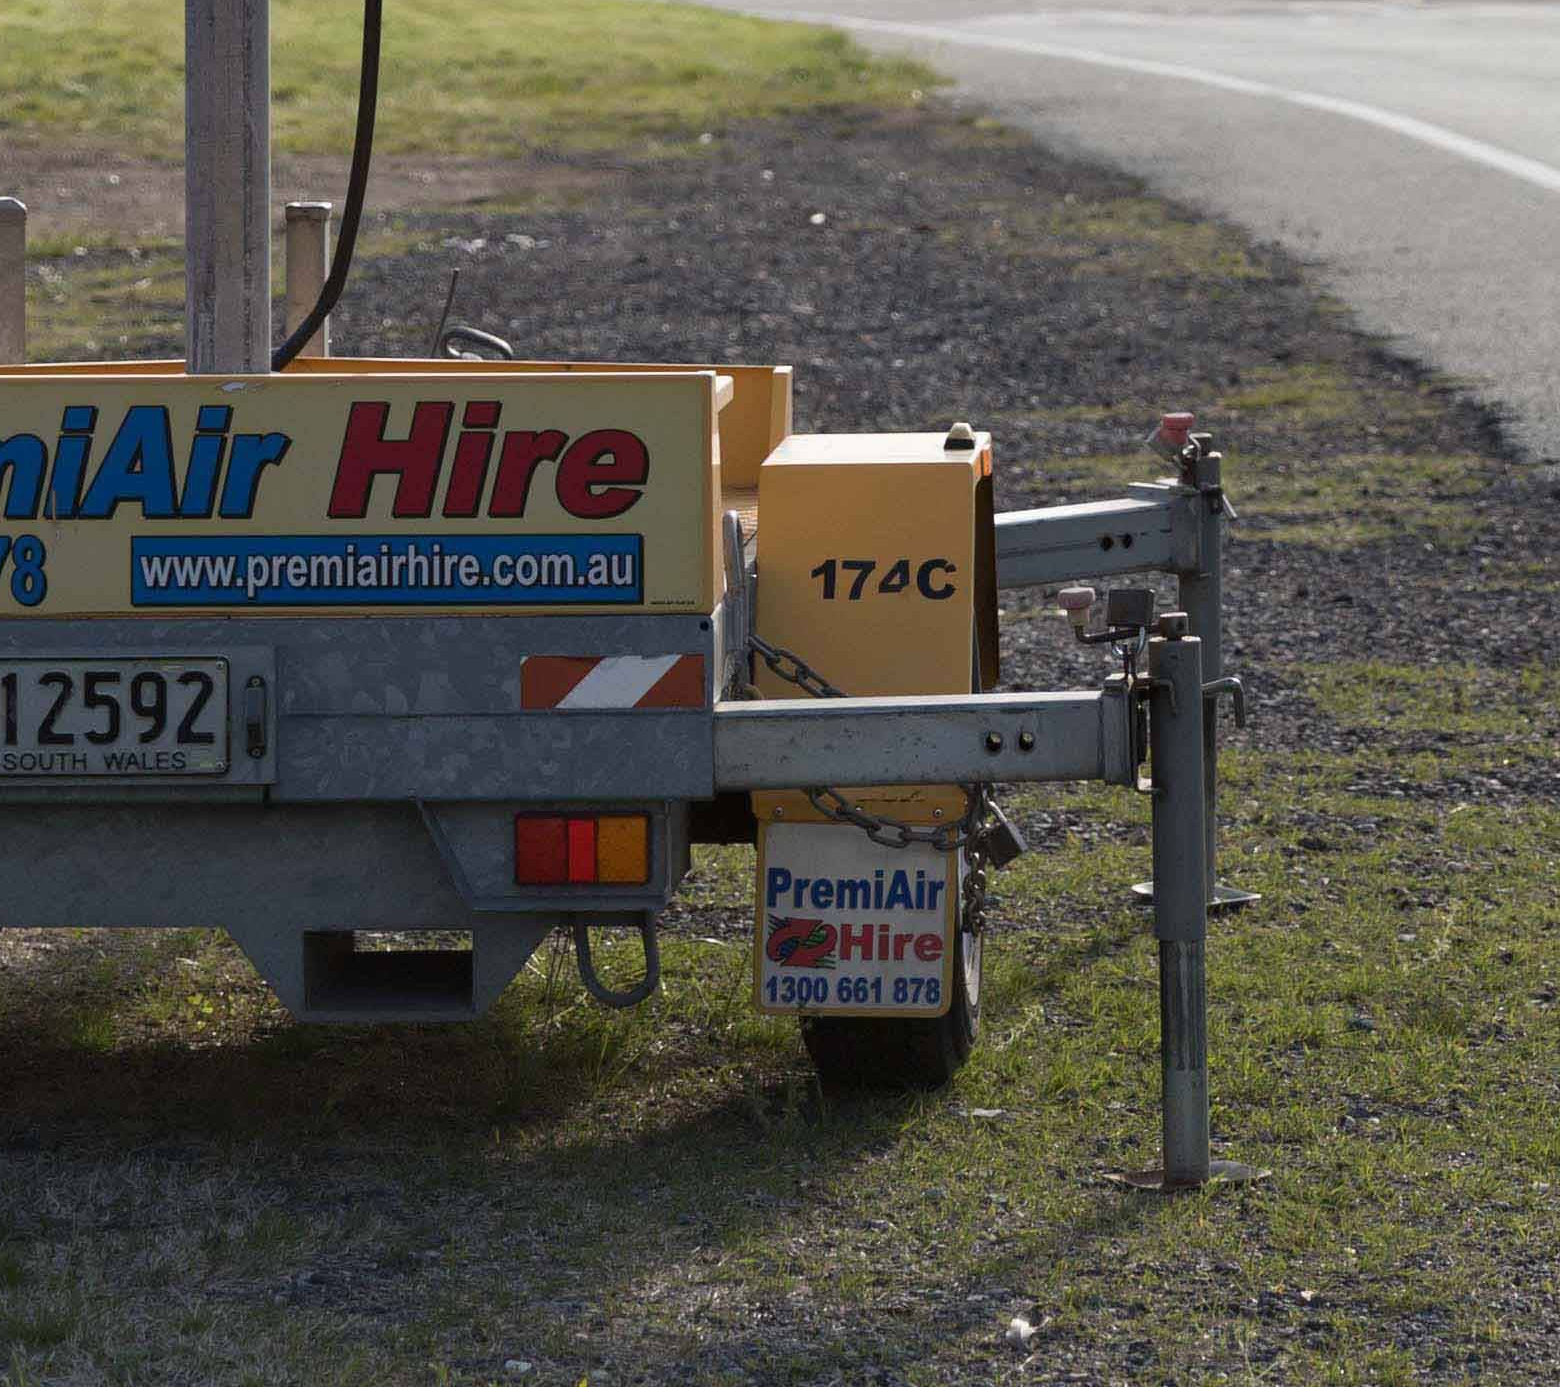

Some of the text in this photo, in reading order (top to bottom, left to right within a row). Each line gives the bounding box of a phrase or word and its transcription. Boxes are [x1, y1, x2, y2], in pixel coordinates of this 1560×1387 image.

[326, 399, 651, 520] Hire
[140, 543, 635, 601] www.premiairhire.com.au
[810, 557, 957, 601] 174C
[0, 670, 216, 747] 12592
[2, 751, 89, 772] SOUTH
[103, 750, 187, 772] WALES
[767, 867, 945, 911] PremiAir
[840, 923, 945, 962] Hire
[766, 975, 941, 1004] 1300 661 878
